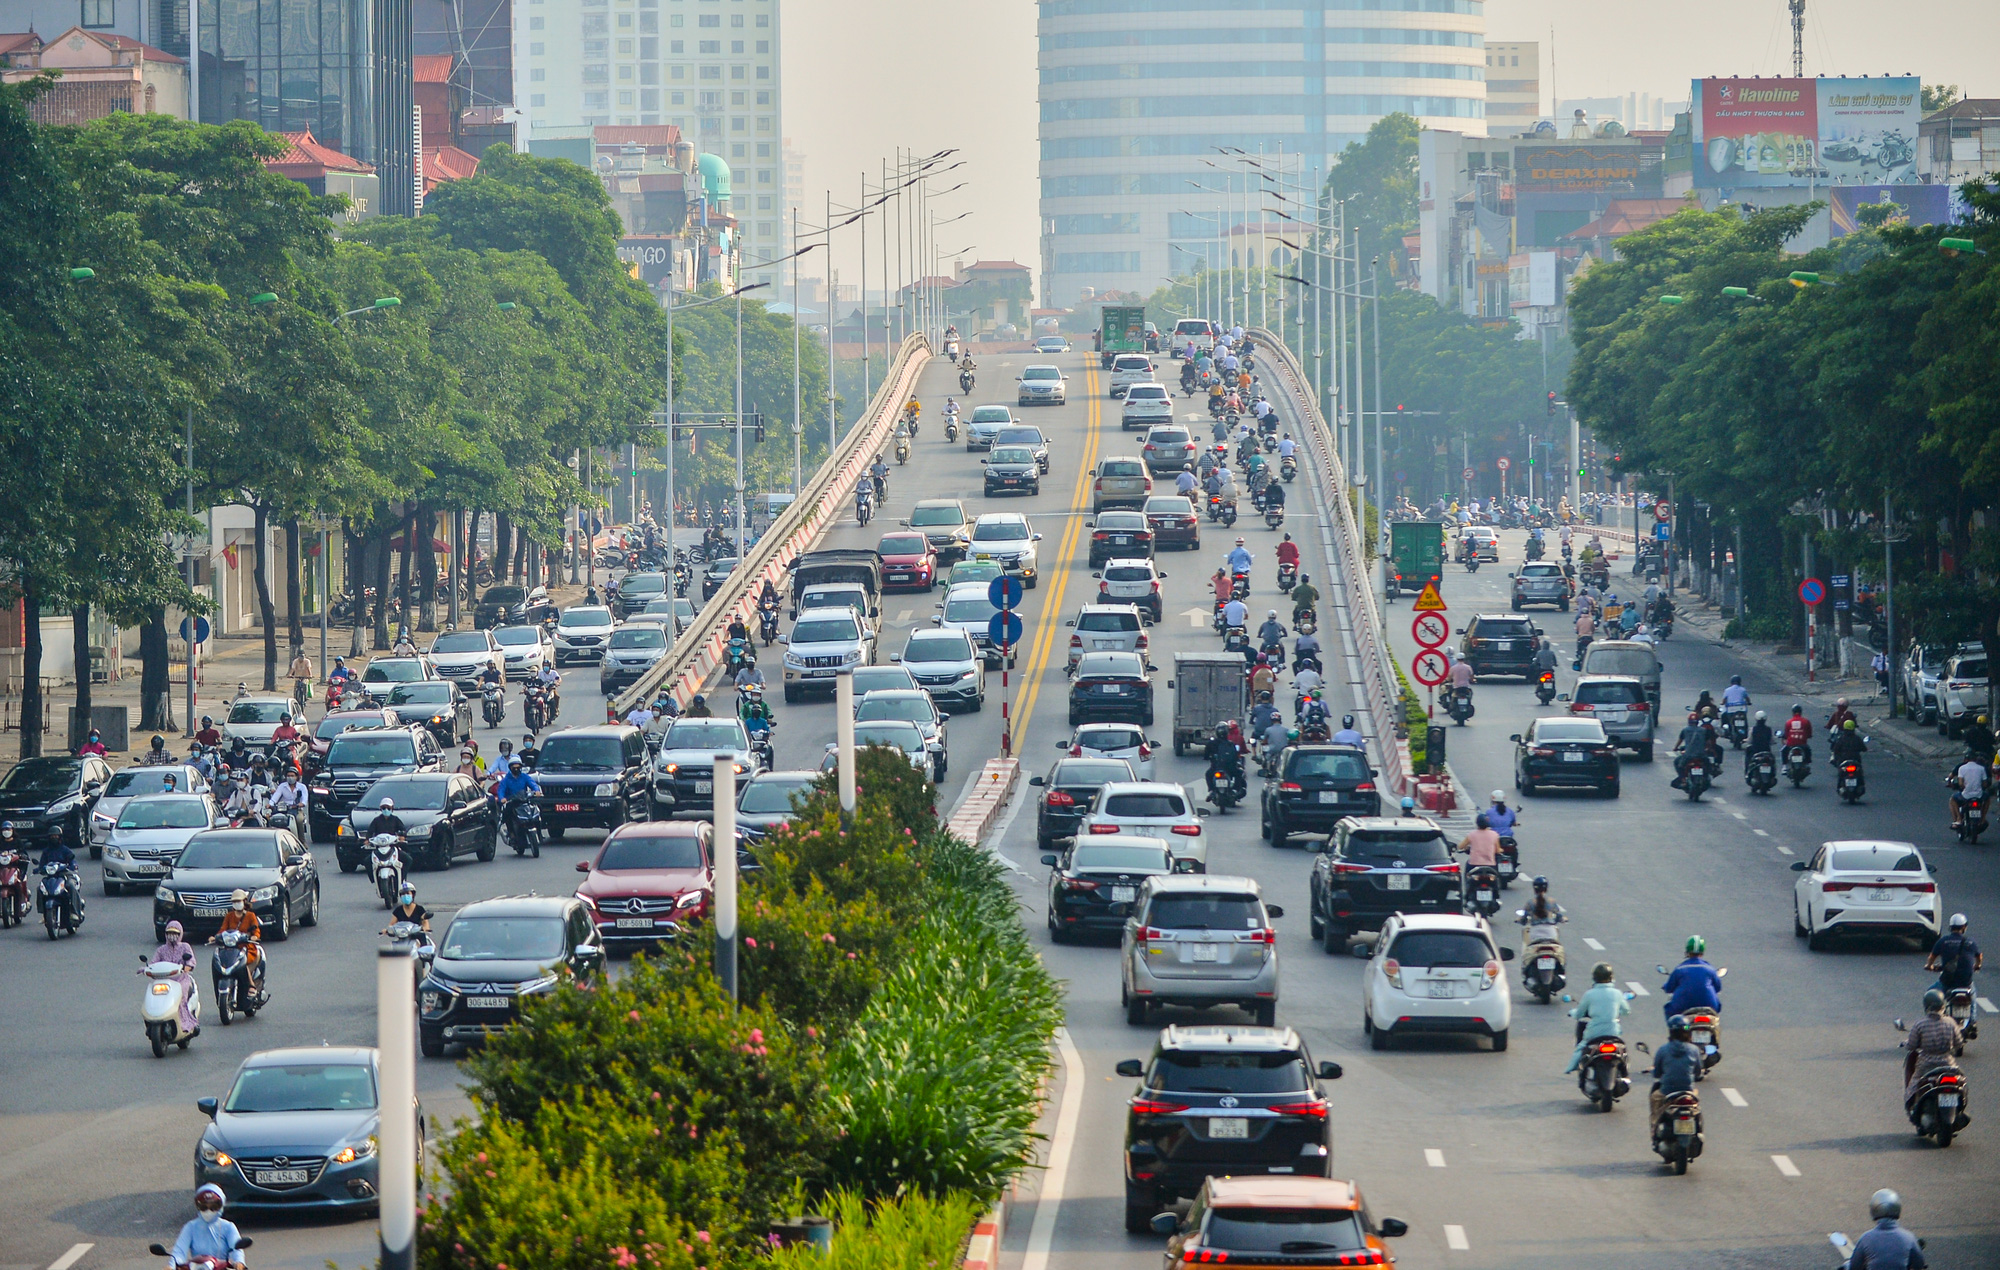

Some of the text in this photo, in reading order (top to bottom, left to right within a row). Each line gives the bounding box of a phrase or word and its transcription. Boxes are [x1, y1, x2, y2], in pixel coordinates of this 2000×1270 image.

[1738, 88, 1800, 102] Havoline
[1829, 92, 1913, 108] LÀM CHỦ ĐỘNG CƠ
[256, 1170, 306, 1183] 30E-454.36
